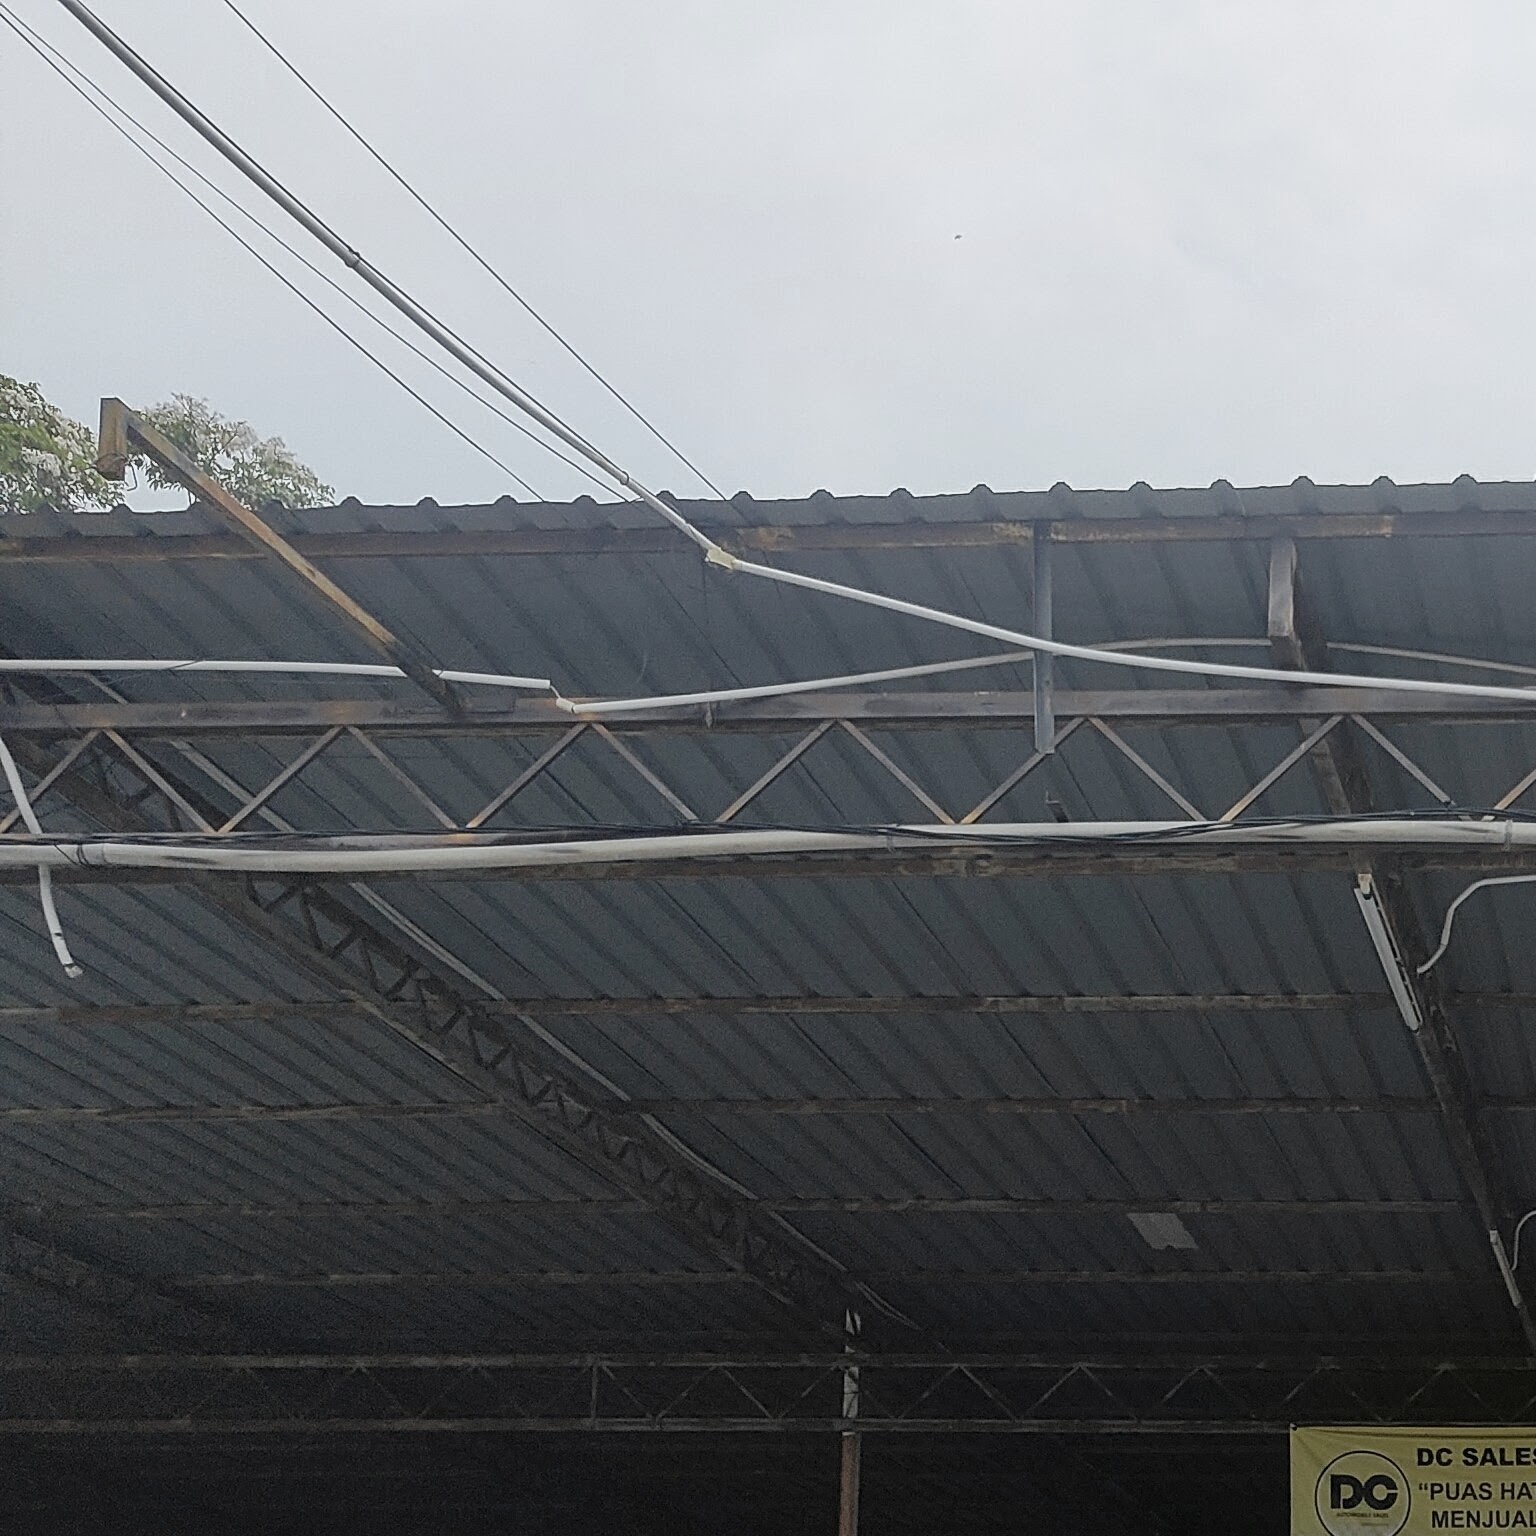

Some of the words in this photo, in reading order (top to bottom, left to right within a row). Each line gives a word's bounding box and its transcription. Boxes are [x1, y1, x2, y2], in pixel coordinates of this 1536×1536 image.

[1417, 1447, 1453, 1466] DC
[1330, 1474, 1398, 1510] DC
[1418, 1482, 1493, 1500] “PUAS
